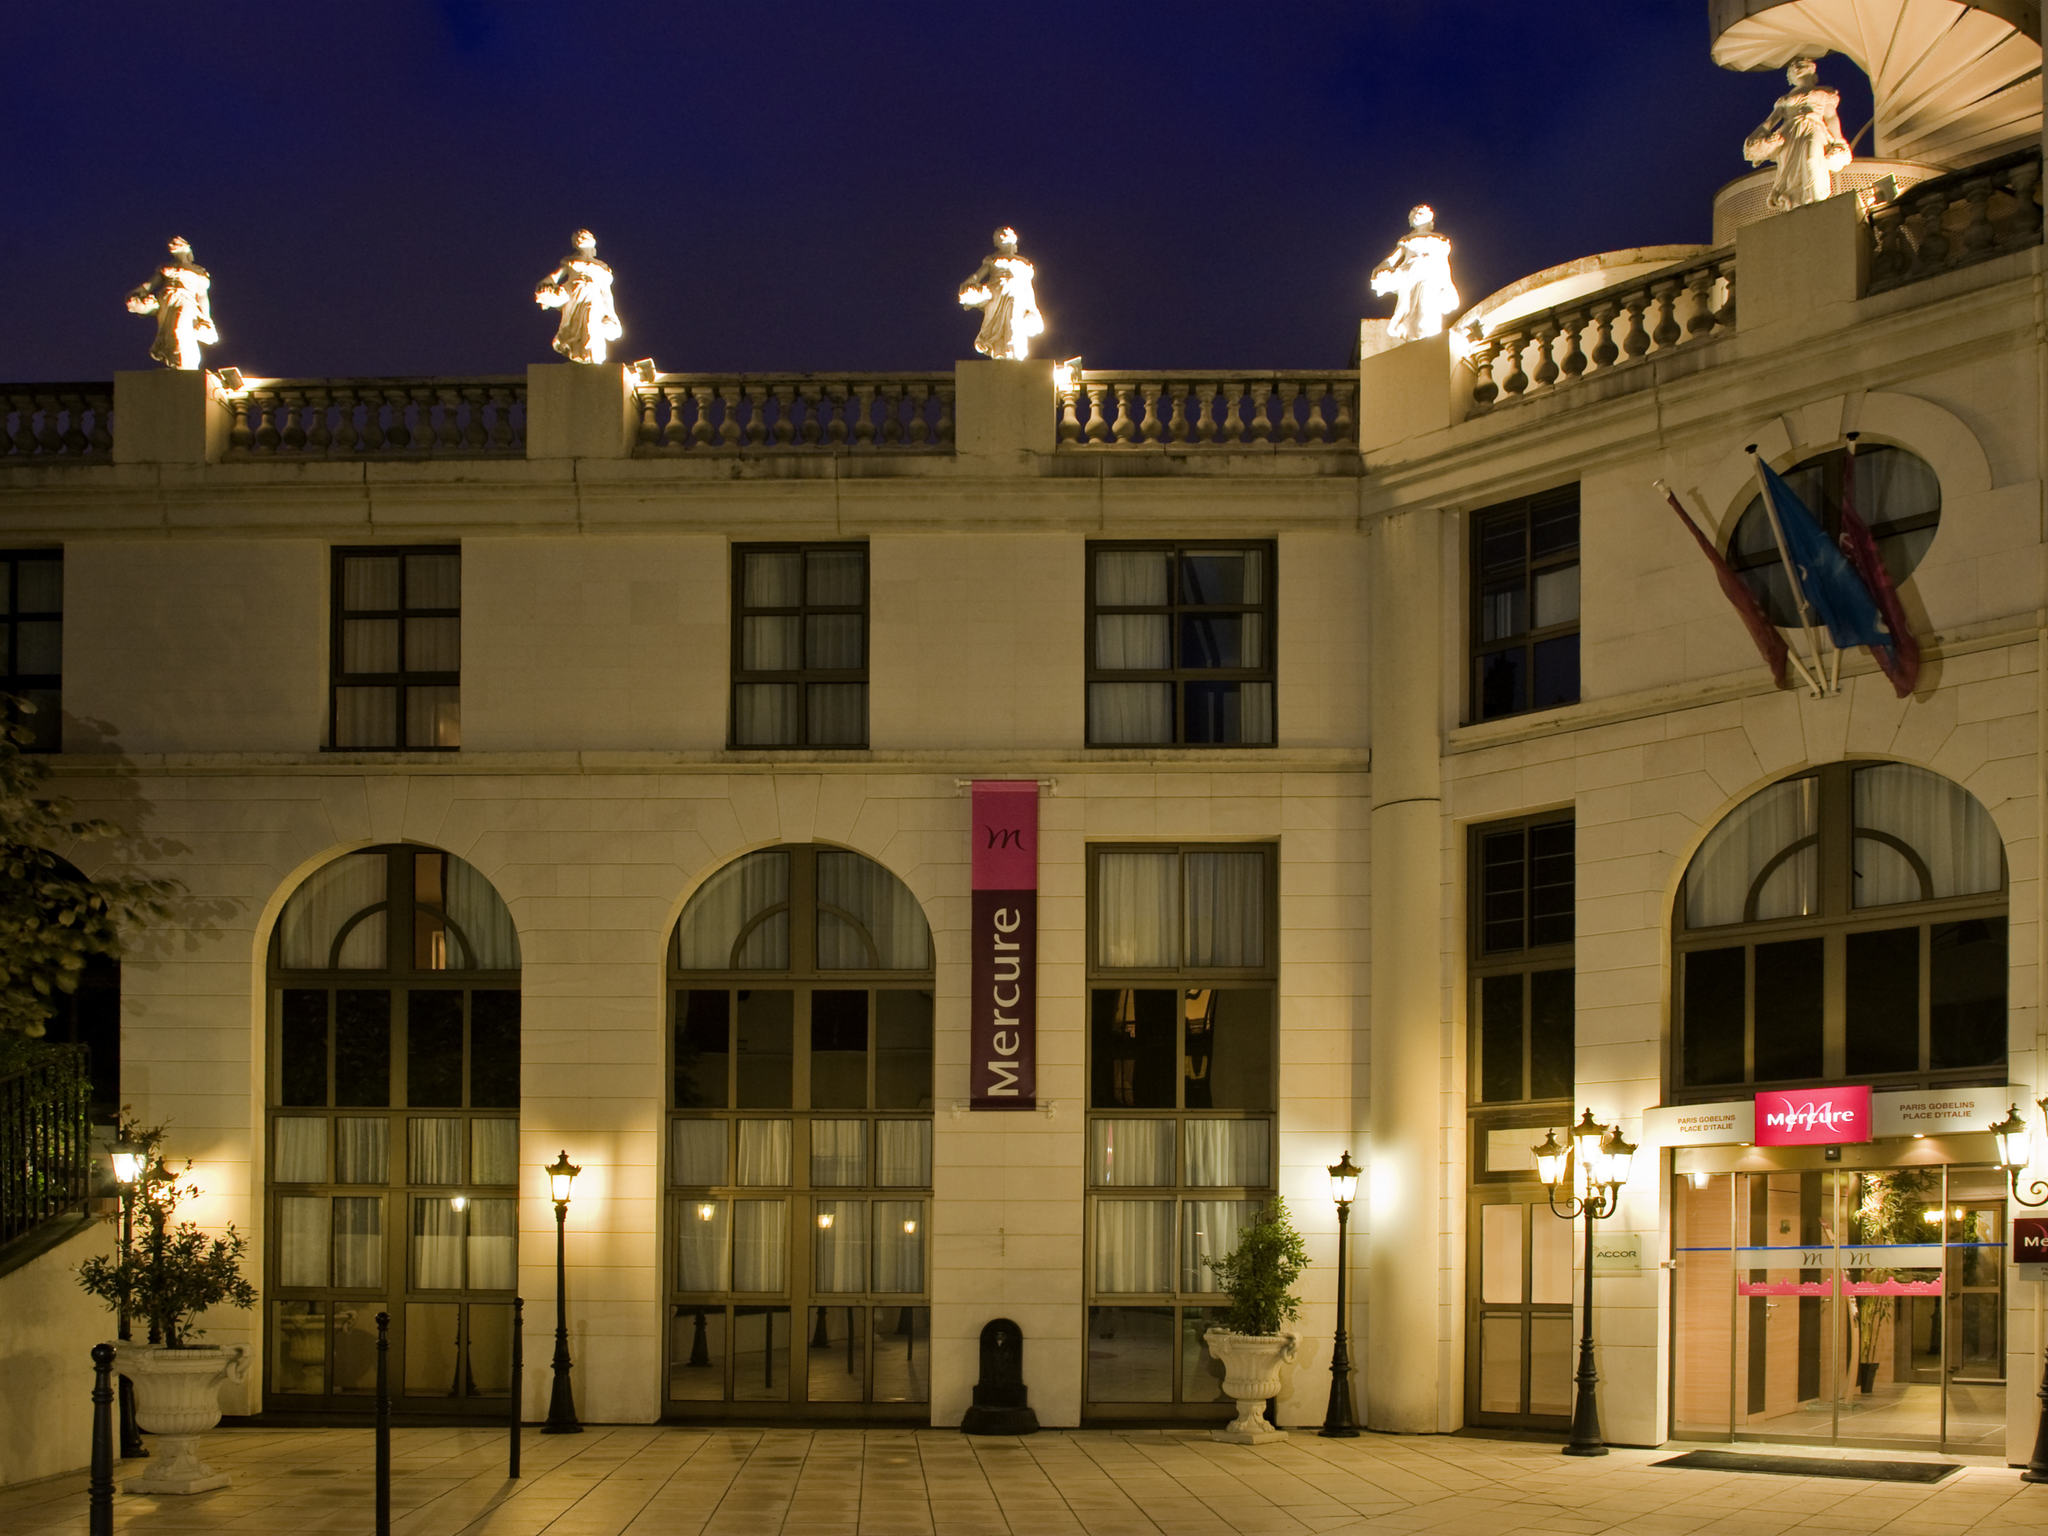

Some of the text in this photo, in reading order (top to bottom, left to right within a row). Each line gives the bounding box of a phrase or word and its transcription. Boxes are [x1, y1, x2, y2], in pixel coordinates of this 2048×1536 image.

[987, 907, 1021, 1096] Mercure
[1899, 1101, 1975, 1112] PARIS GOBELINS
[1699, 1114, 1736, 1123] GOBELINS
[1767, 1110, 1855, 1126] Mercure
[1903, 1110, 1972, 1120] PLACE D'ITALIE
[1703, 1123, 1733, 1131] D'ITALIE
[1596, 1250, 1637, 1258] ACCOR
